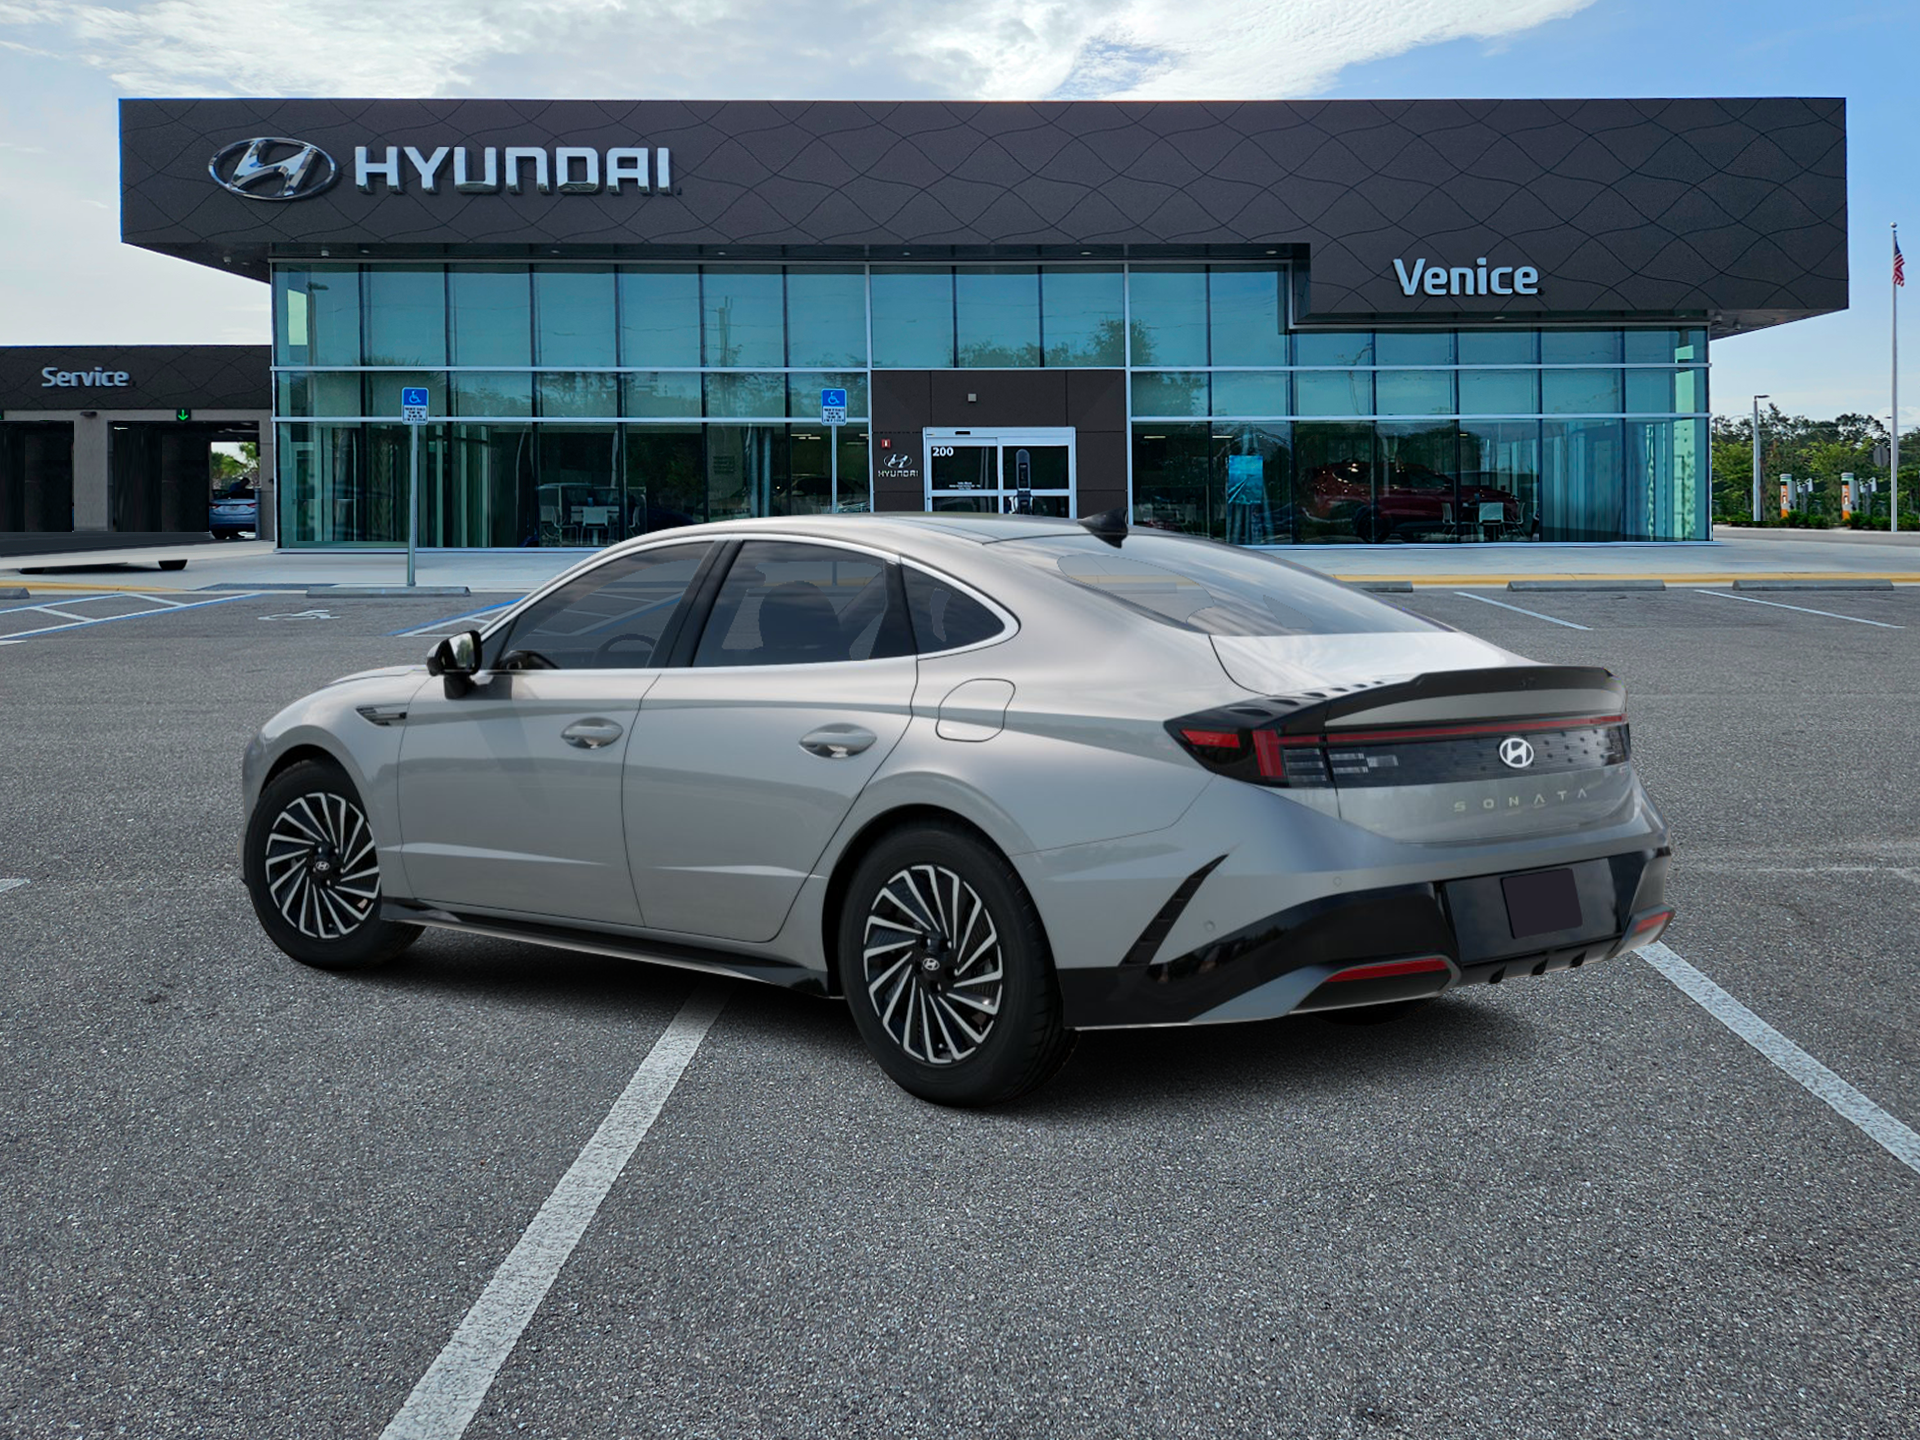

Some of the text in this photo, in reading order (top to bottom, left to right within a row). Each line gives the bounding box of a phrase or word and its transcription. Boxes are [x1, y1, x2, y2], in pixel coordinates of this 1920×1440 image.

[354, 146, 673, 194] HYUNDAI
[1393, 257, 1539, 295] Venice
[41, 366, 130, 387] Service
[932, 446, 954, 457] 200
[878, 470, 919, 478] HYUNDAI
[1453, 788, 1588, 812] SONATA
